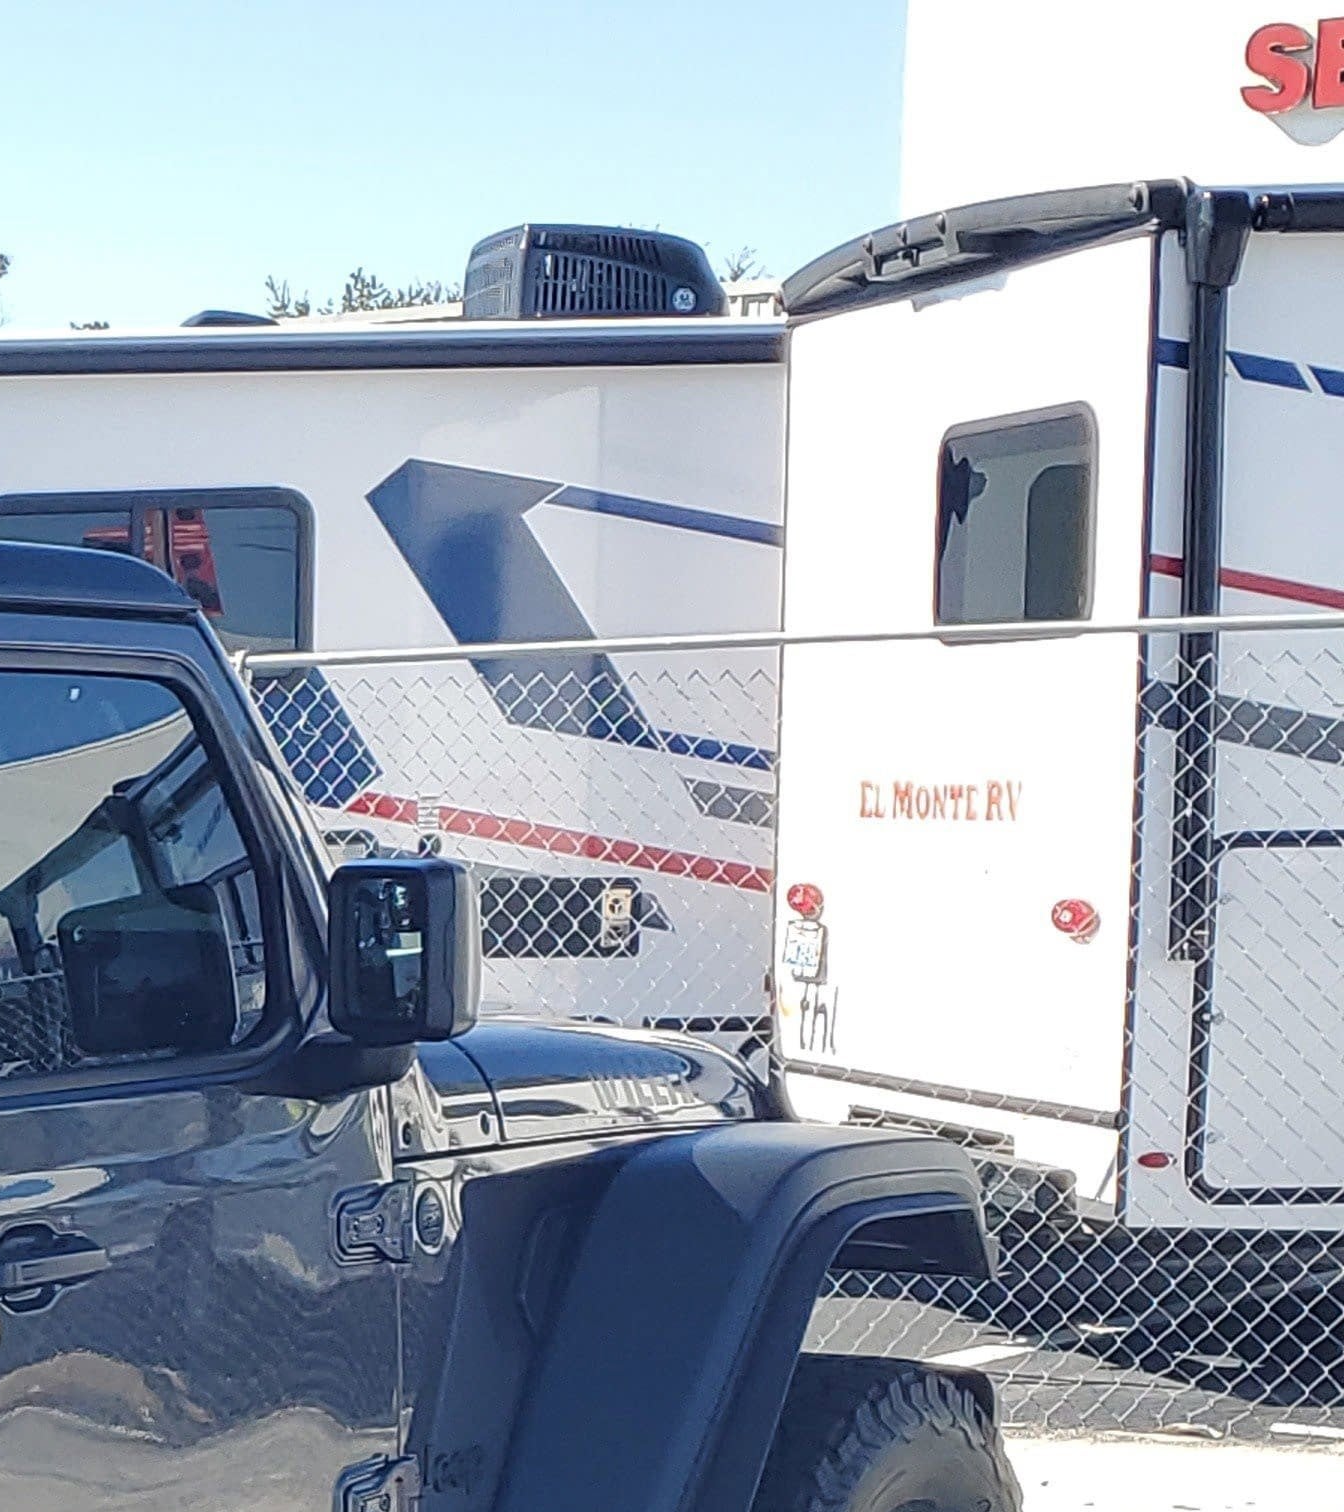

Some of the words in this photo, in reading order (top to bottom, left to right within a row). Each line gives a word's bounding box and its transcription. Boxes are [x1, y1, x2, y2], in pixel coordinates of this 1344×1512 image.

[860, 780, 885, 819] EL
[892, 780, 978, 821] MONTE
[985, 779, 1022, 821] RV
